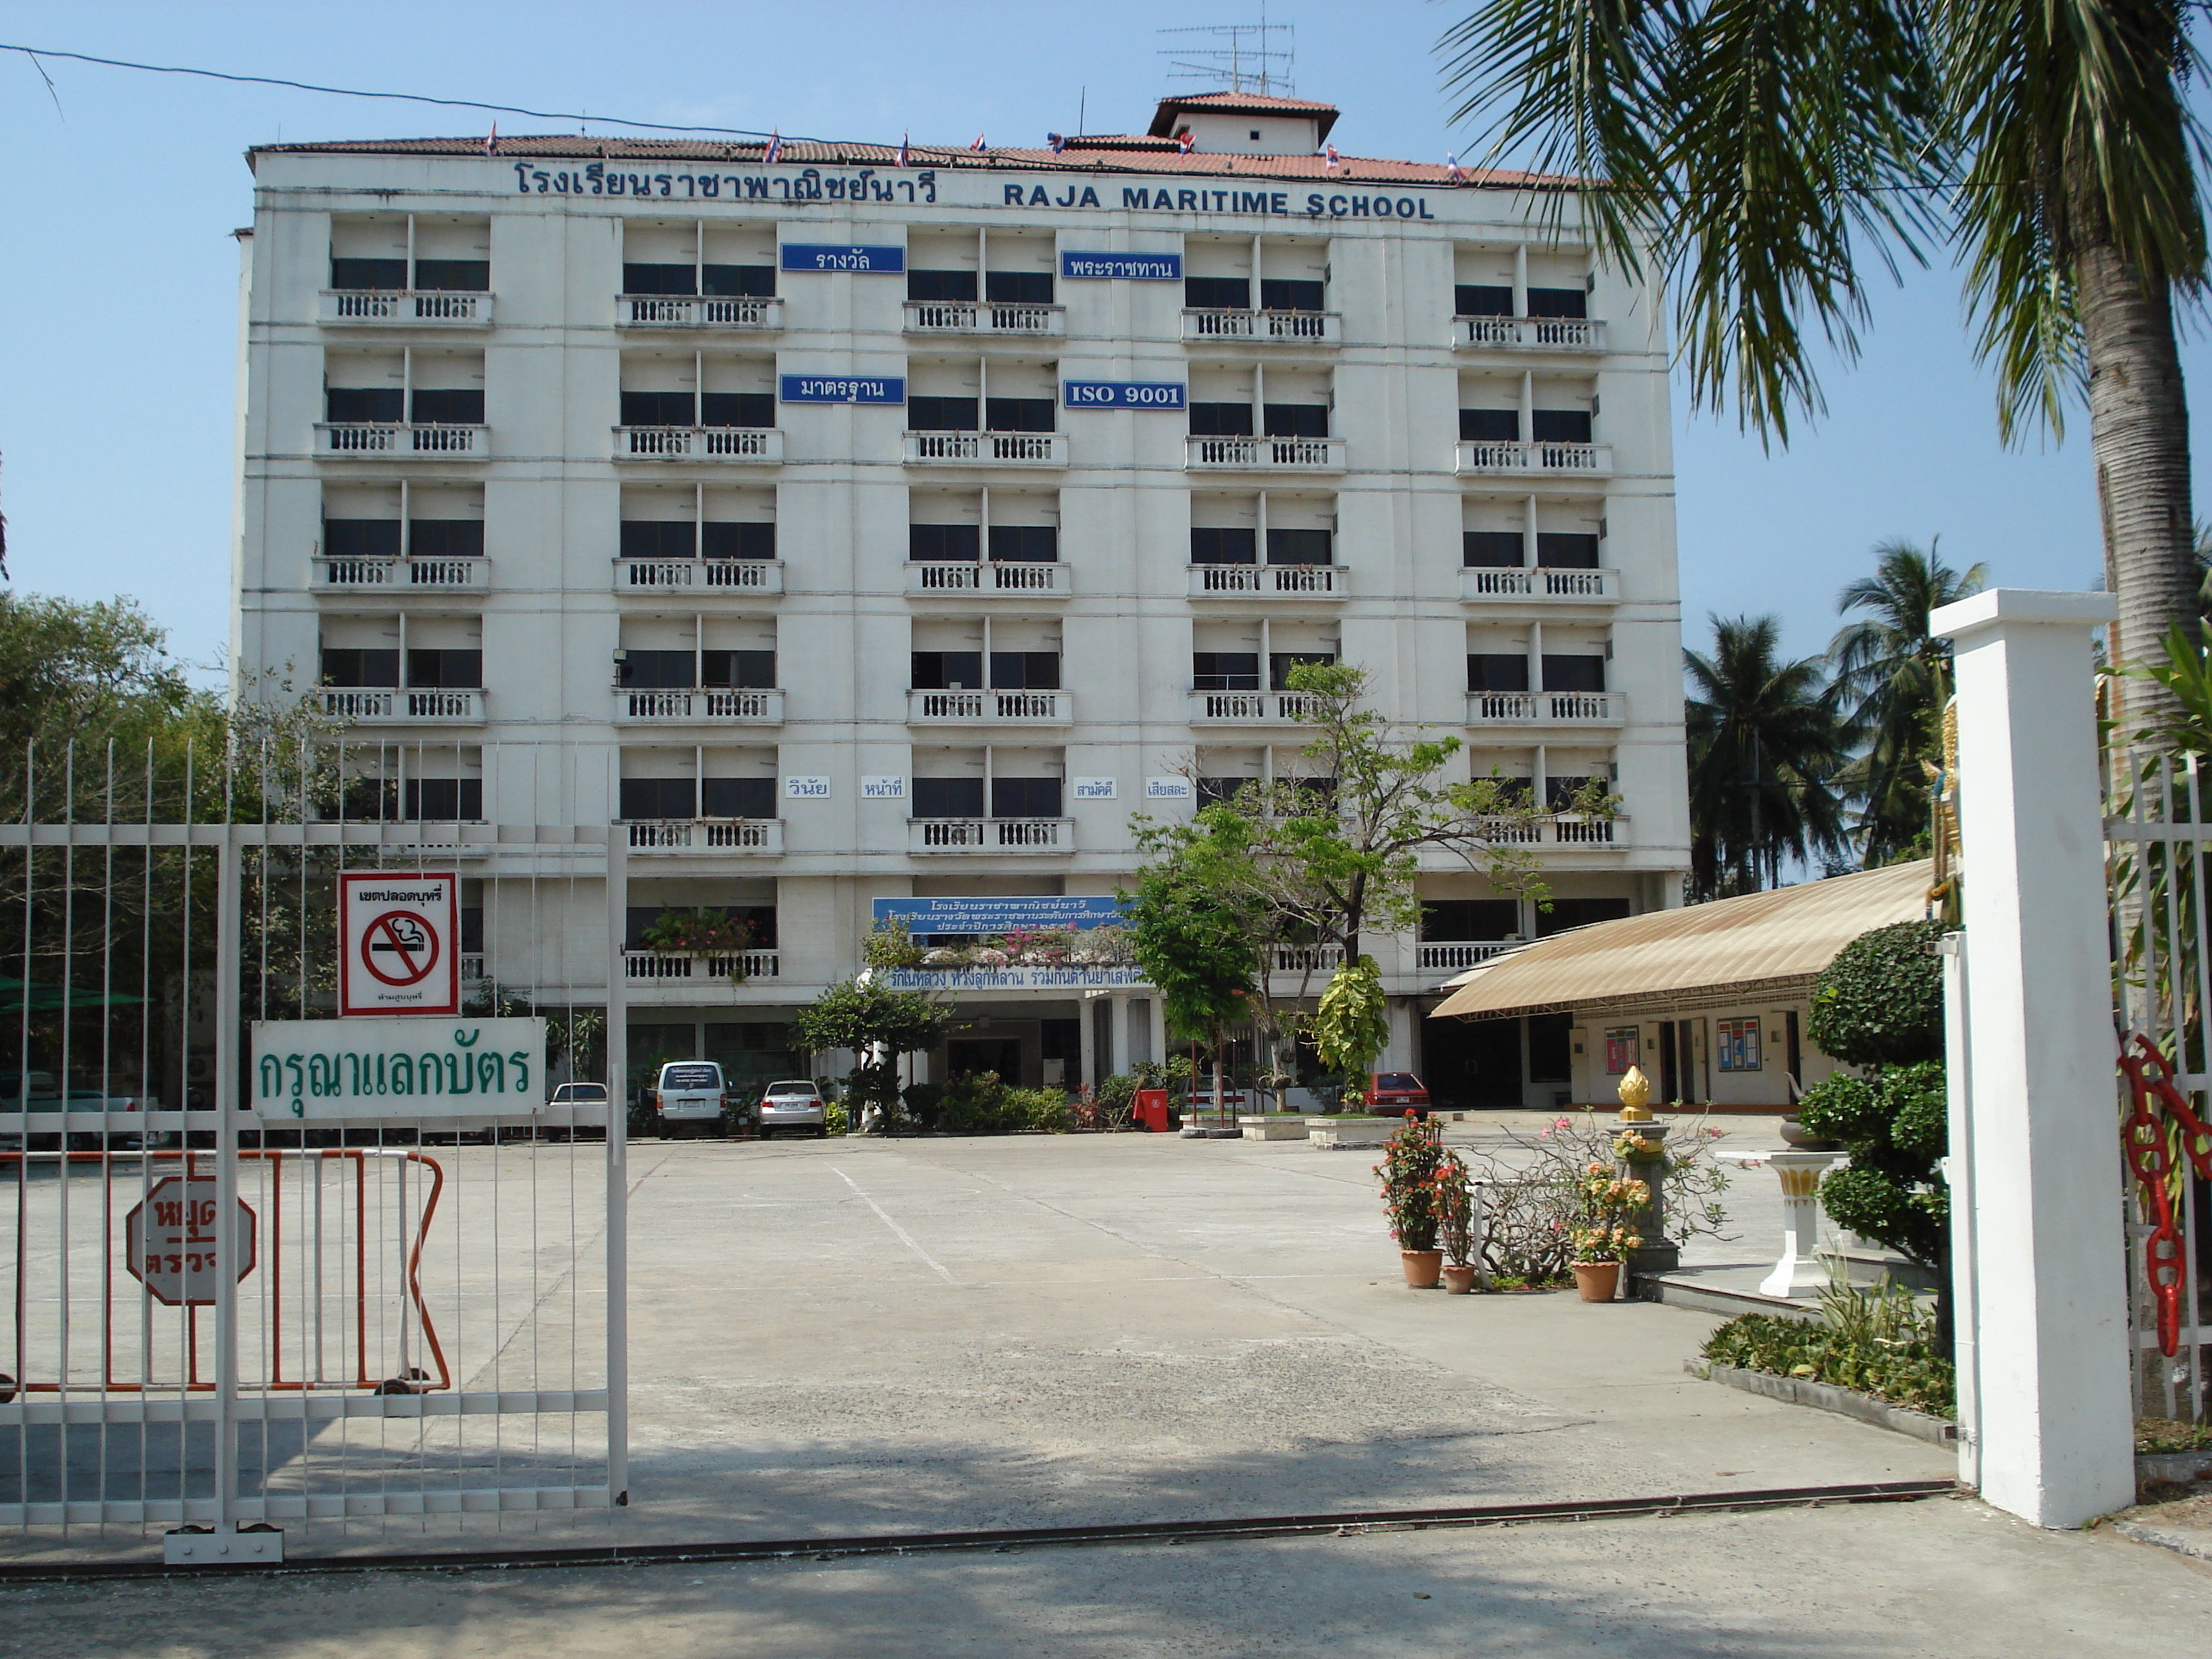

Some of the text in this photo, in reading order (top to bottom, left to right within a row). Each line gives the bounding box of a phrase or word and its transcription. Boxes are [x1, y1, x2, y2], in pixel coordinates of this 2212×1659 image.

[514, 161, 936, 202] โรงเรียนราชาพาณิชย์นาวี
[1004, 184, 1434, 219] RAJA MARITIME SCHOOL
[816, 248, 870, 269] รางวัล
[1070, 261, 1172, 278] พระราชทาน
[801, 379, 884, 403] มาตรฐาน
[1071, 386, 1179, 404] ISO 9001
[789, 778, 827, 795] วินัย
[865, 777, 902, 796] หน้าที่
[1077, 781, 1112, 796] สามัคคี
[1148, 781, 1187, 796] เสียสละ
[359, 884, 442, 907] เขตปลอดบุหรี่
[931, 899, 1087, 911] โรงเรียนราชาพาณิชย์นาวี
[891, 967, 946, 986] รักในหลวง
[378, 991, 423, 1002] ห้ามสูบบุหรี่
[259, 1028, 530, 1119] กรุณาแลกบัตร
